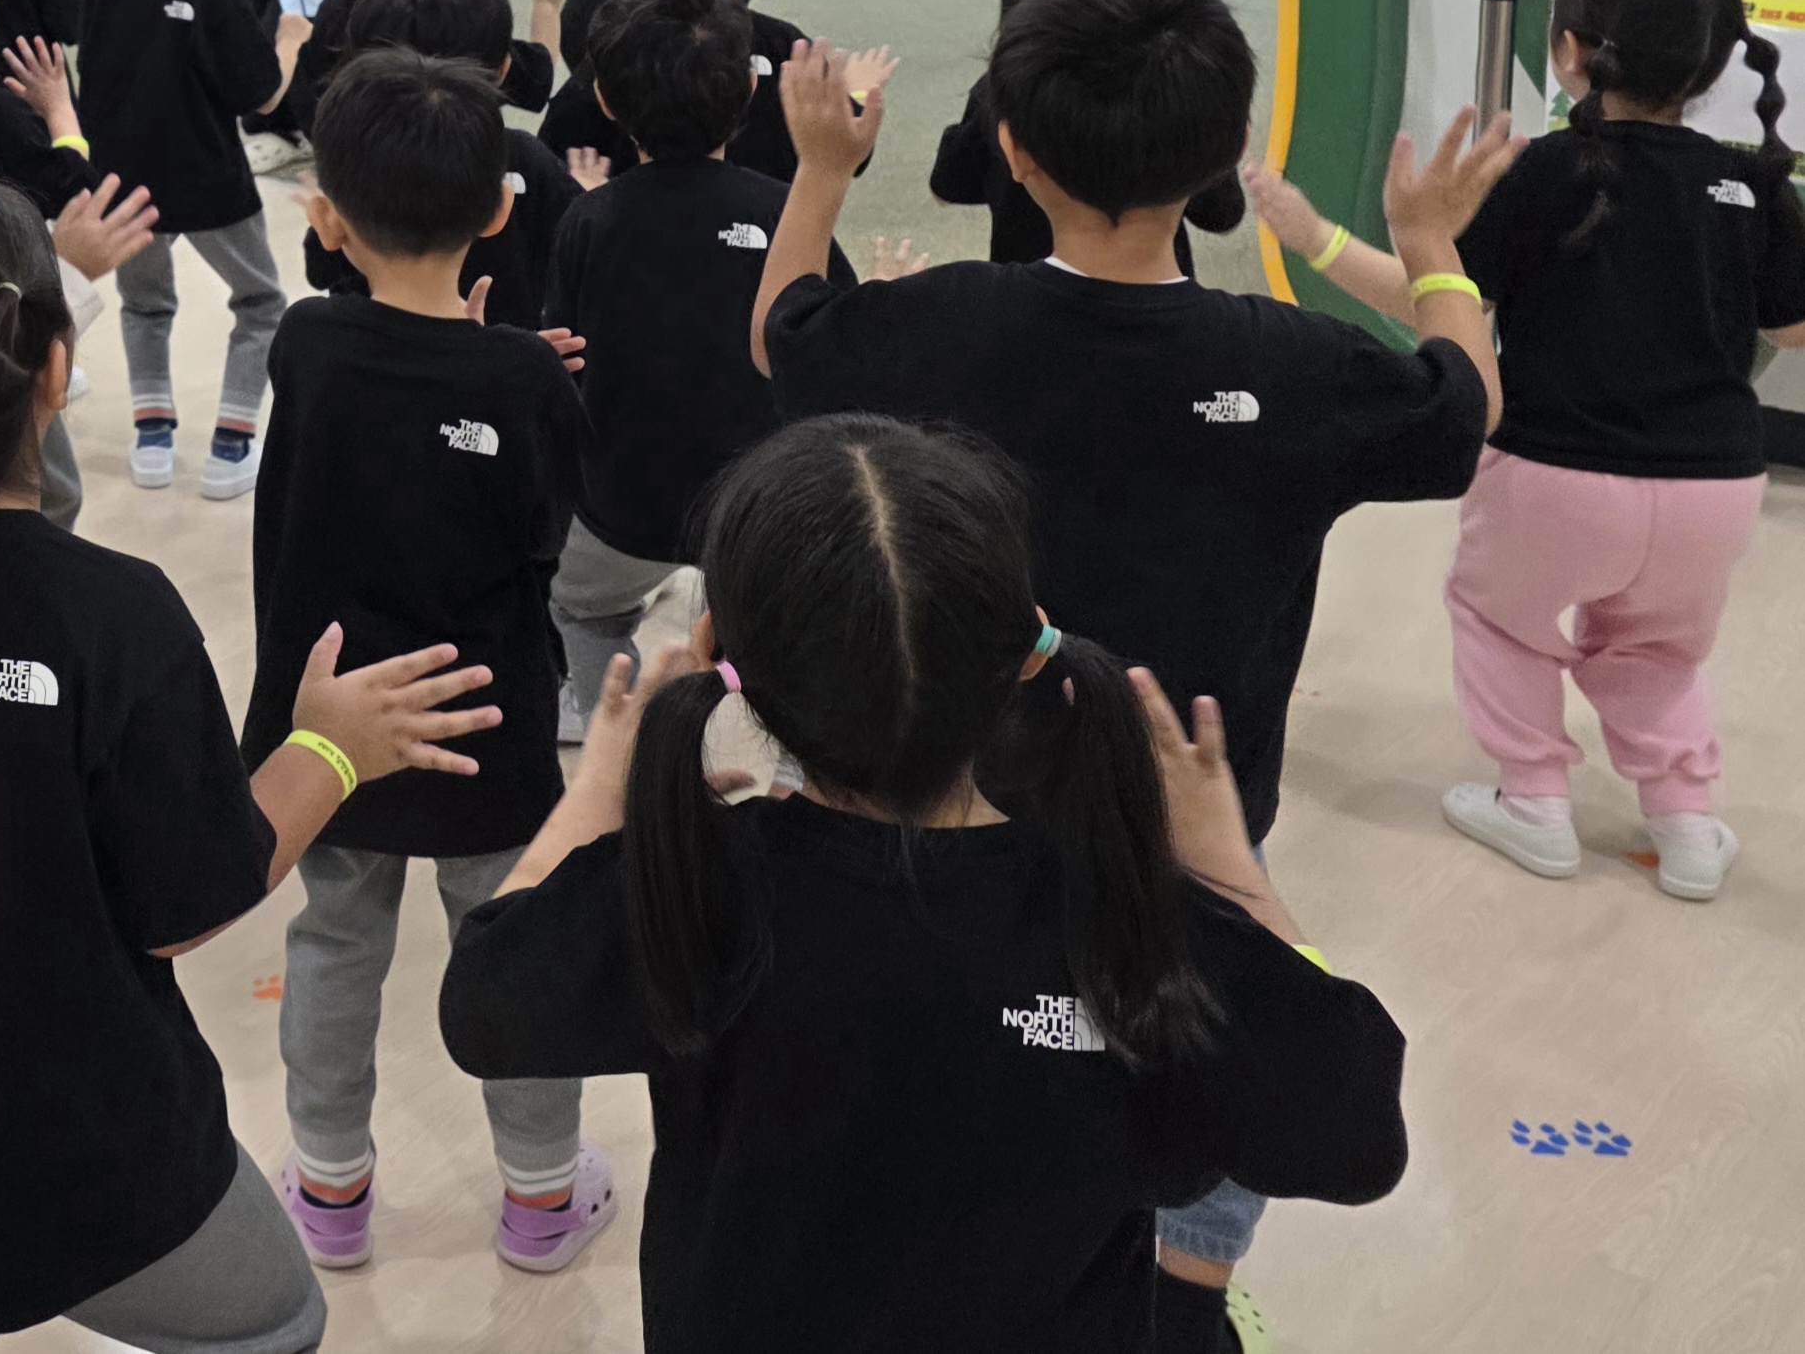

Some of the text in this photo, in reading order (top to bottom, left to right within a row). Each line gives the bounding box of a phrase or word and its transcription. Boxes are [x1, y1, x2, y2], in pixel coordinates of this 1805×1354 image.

[439, 423, 481, 443] NORTH
[459, 419, 482, 434] THE
[0, 659, 31, 674] THE
[1036, 994, 1074, 1014] THE
[1002, 1007, 1073, 1032] NORTH
[1022, 1028, 1073, 1050] FACE
